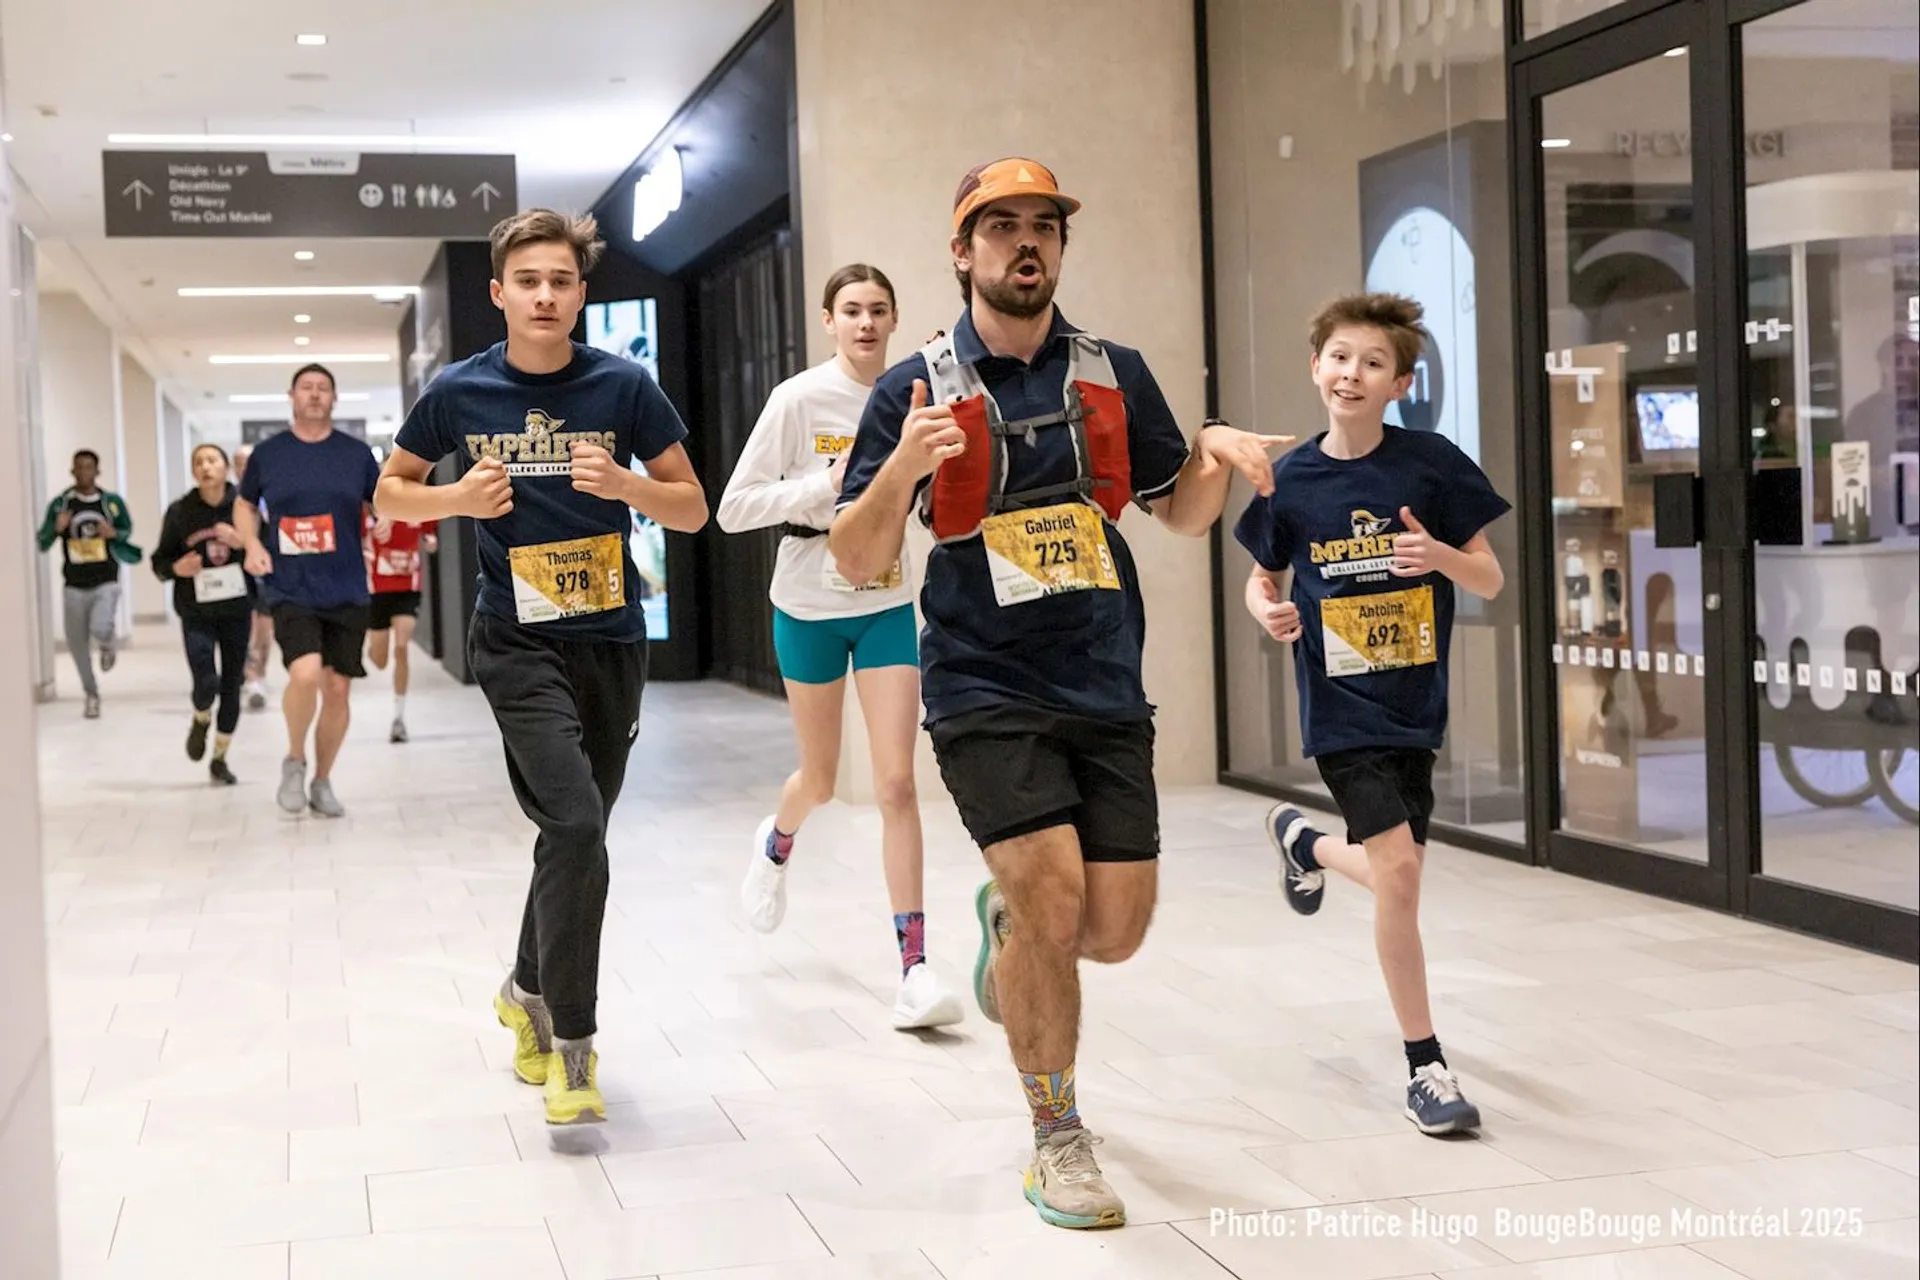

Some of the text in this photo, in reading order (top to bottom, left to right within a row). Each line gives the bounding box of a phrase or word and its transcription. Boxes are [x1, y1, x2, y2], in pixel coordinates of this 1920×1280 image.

[168, 194, 227, 209] Old Navy
[170, 210, 273, 224] Time Out Market
[1024, 514, 1077, 535] Gabriel
[545, 549, 593, 566] Thomas
[1034, 539, 1078, 567] 725
[1097, 543, 1111, 571] 5
[555, 570, 590, 593] 978
[607, 568, 620, 593] 5
[1358, 602, 1405, 619] Antoine
[1366, 623, 1401, 648] 692
[1418, 622, 1431, 647] 5
